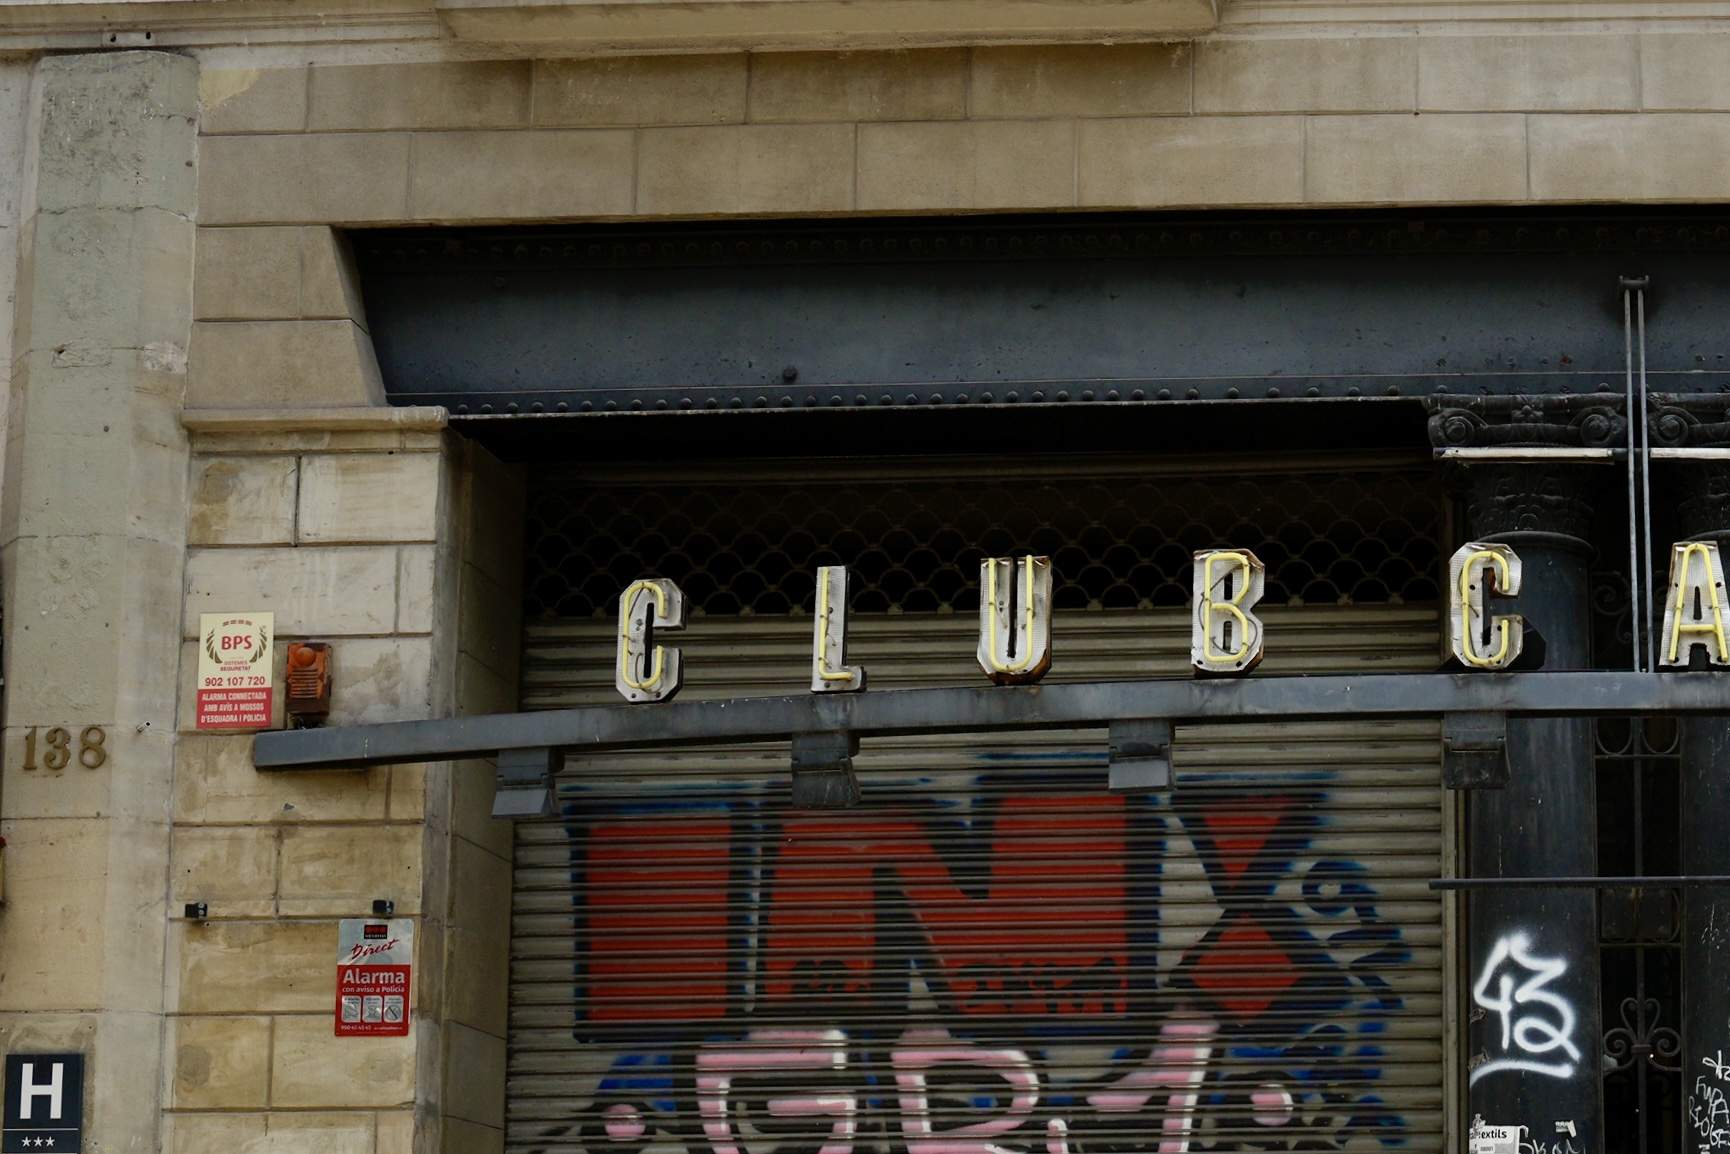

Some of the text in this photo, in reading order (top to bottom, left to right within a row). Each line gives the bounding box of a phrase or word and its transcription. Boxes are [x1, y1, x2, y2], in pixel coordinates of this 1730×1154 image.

[615, 545, 1267, 703] CLUB
[221, 635, 252, 650] BPS
[204, 676, 266, 687] 902 107 720
[202, 692, 267, 701] ALARMA CONNECTADA
[239, 703, 264, 711] MOSSOS
[22, 726, 107, 770] 138
[351, 938, 399, 960] Direct
[343, 968, 405, 984] Alarma
[355, 985, 374, 993] aviso
[20, 1063, 64, 1119] H
[1478, 1128, 1508, 1139] extils
